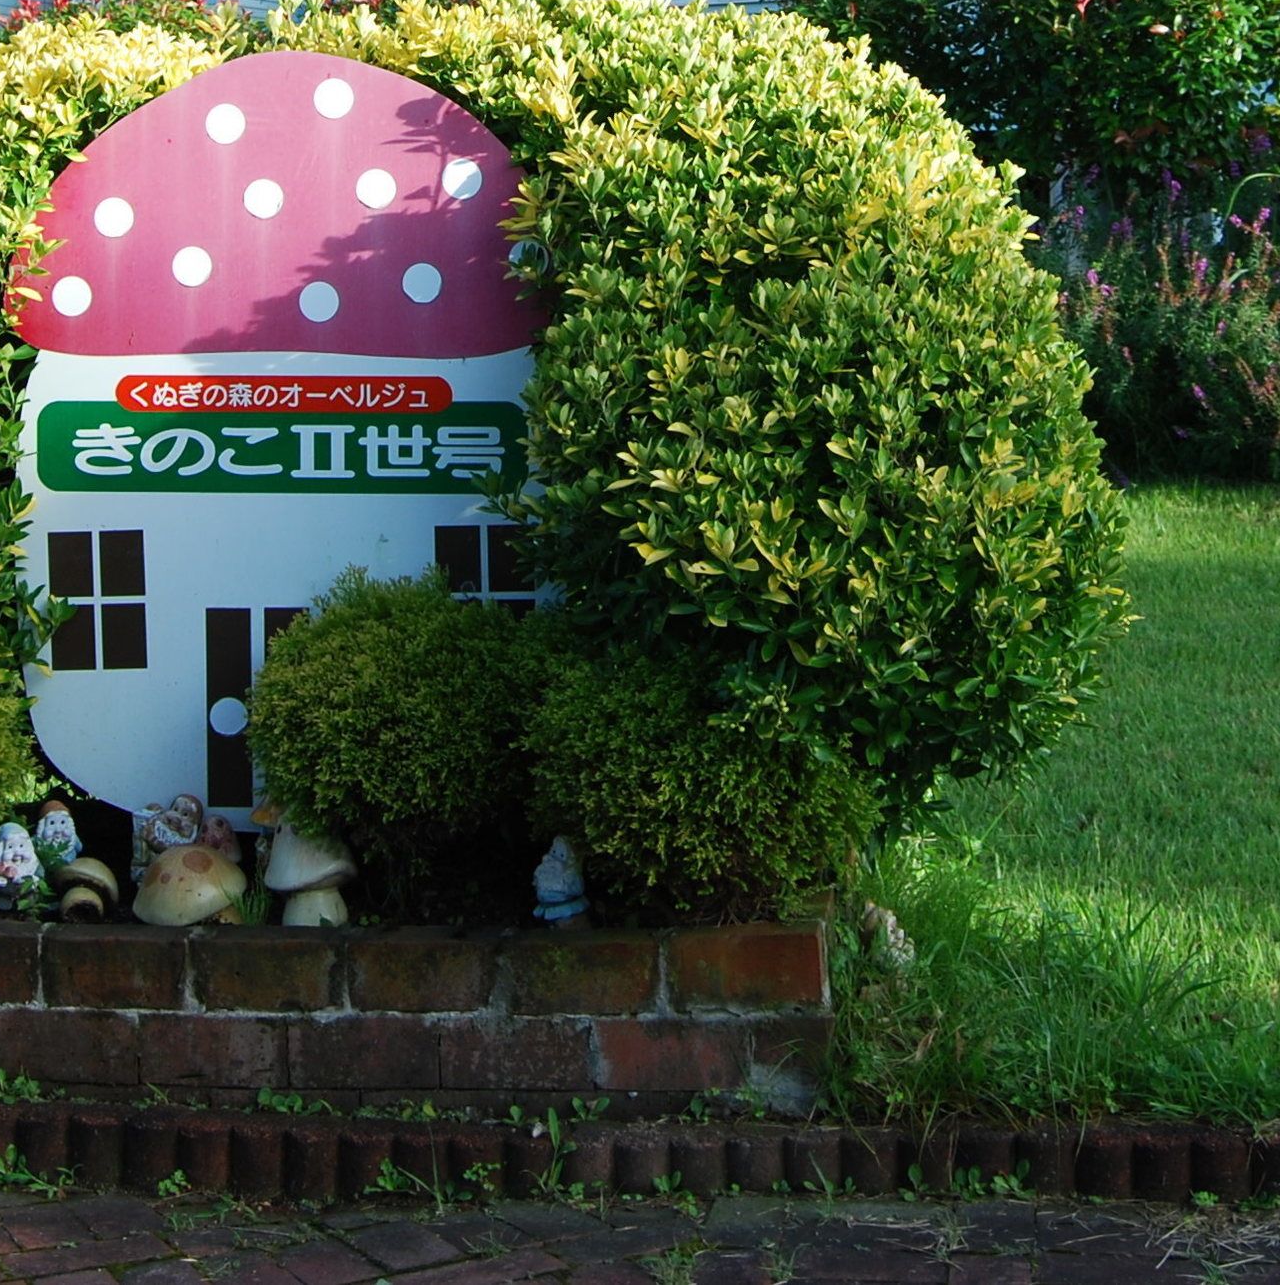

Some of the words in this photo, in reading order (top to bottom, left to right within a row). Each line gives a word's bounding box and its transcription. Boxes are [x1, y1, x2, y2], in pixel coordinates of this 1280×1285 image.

[130, 382, 429, 407] くぬぎの森のオーベルジュ
